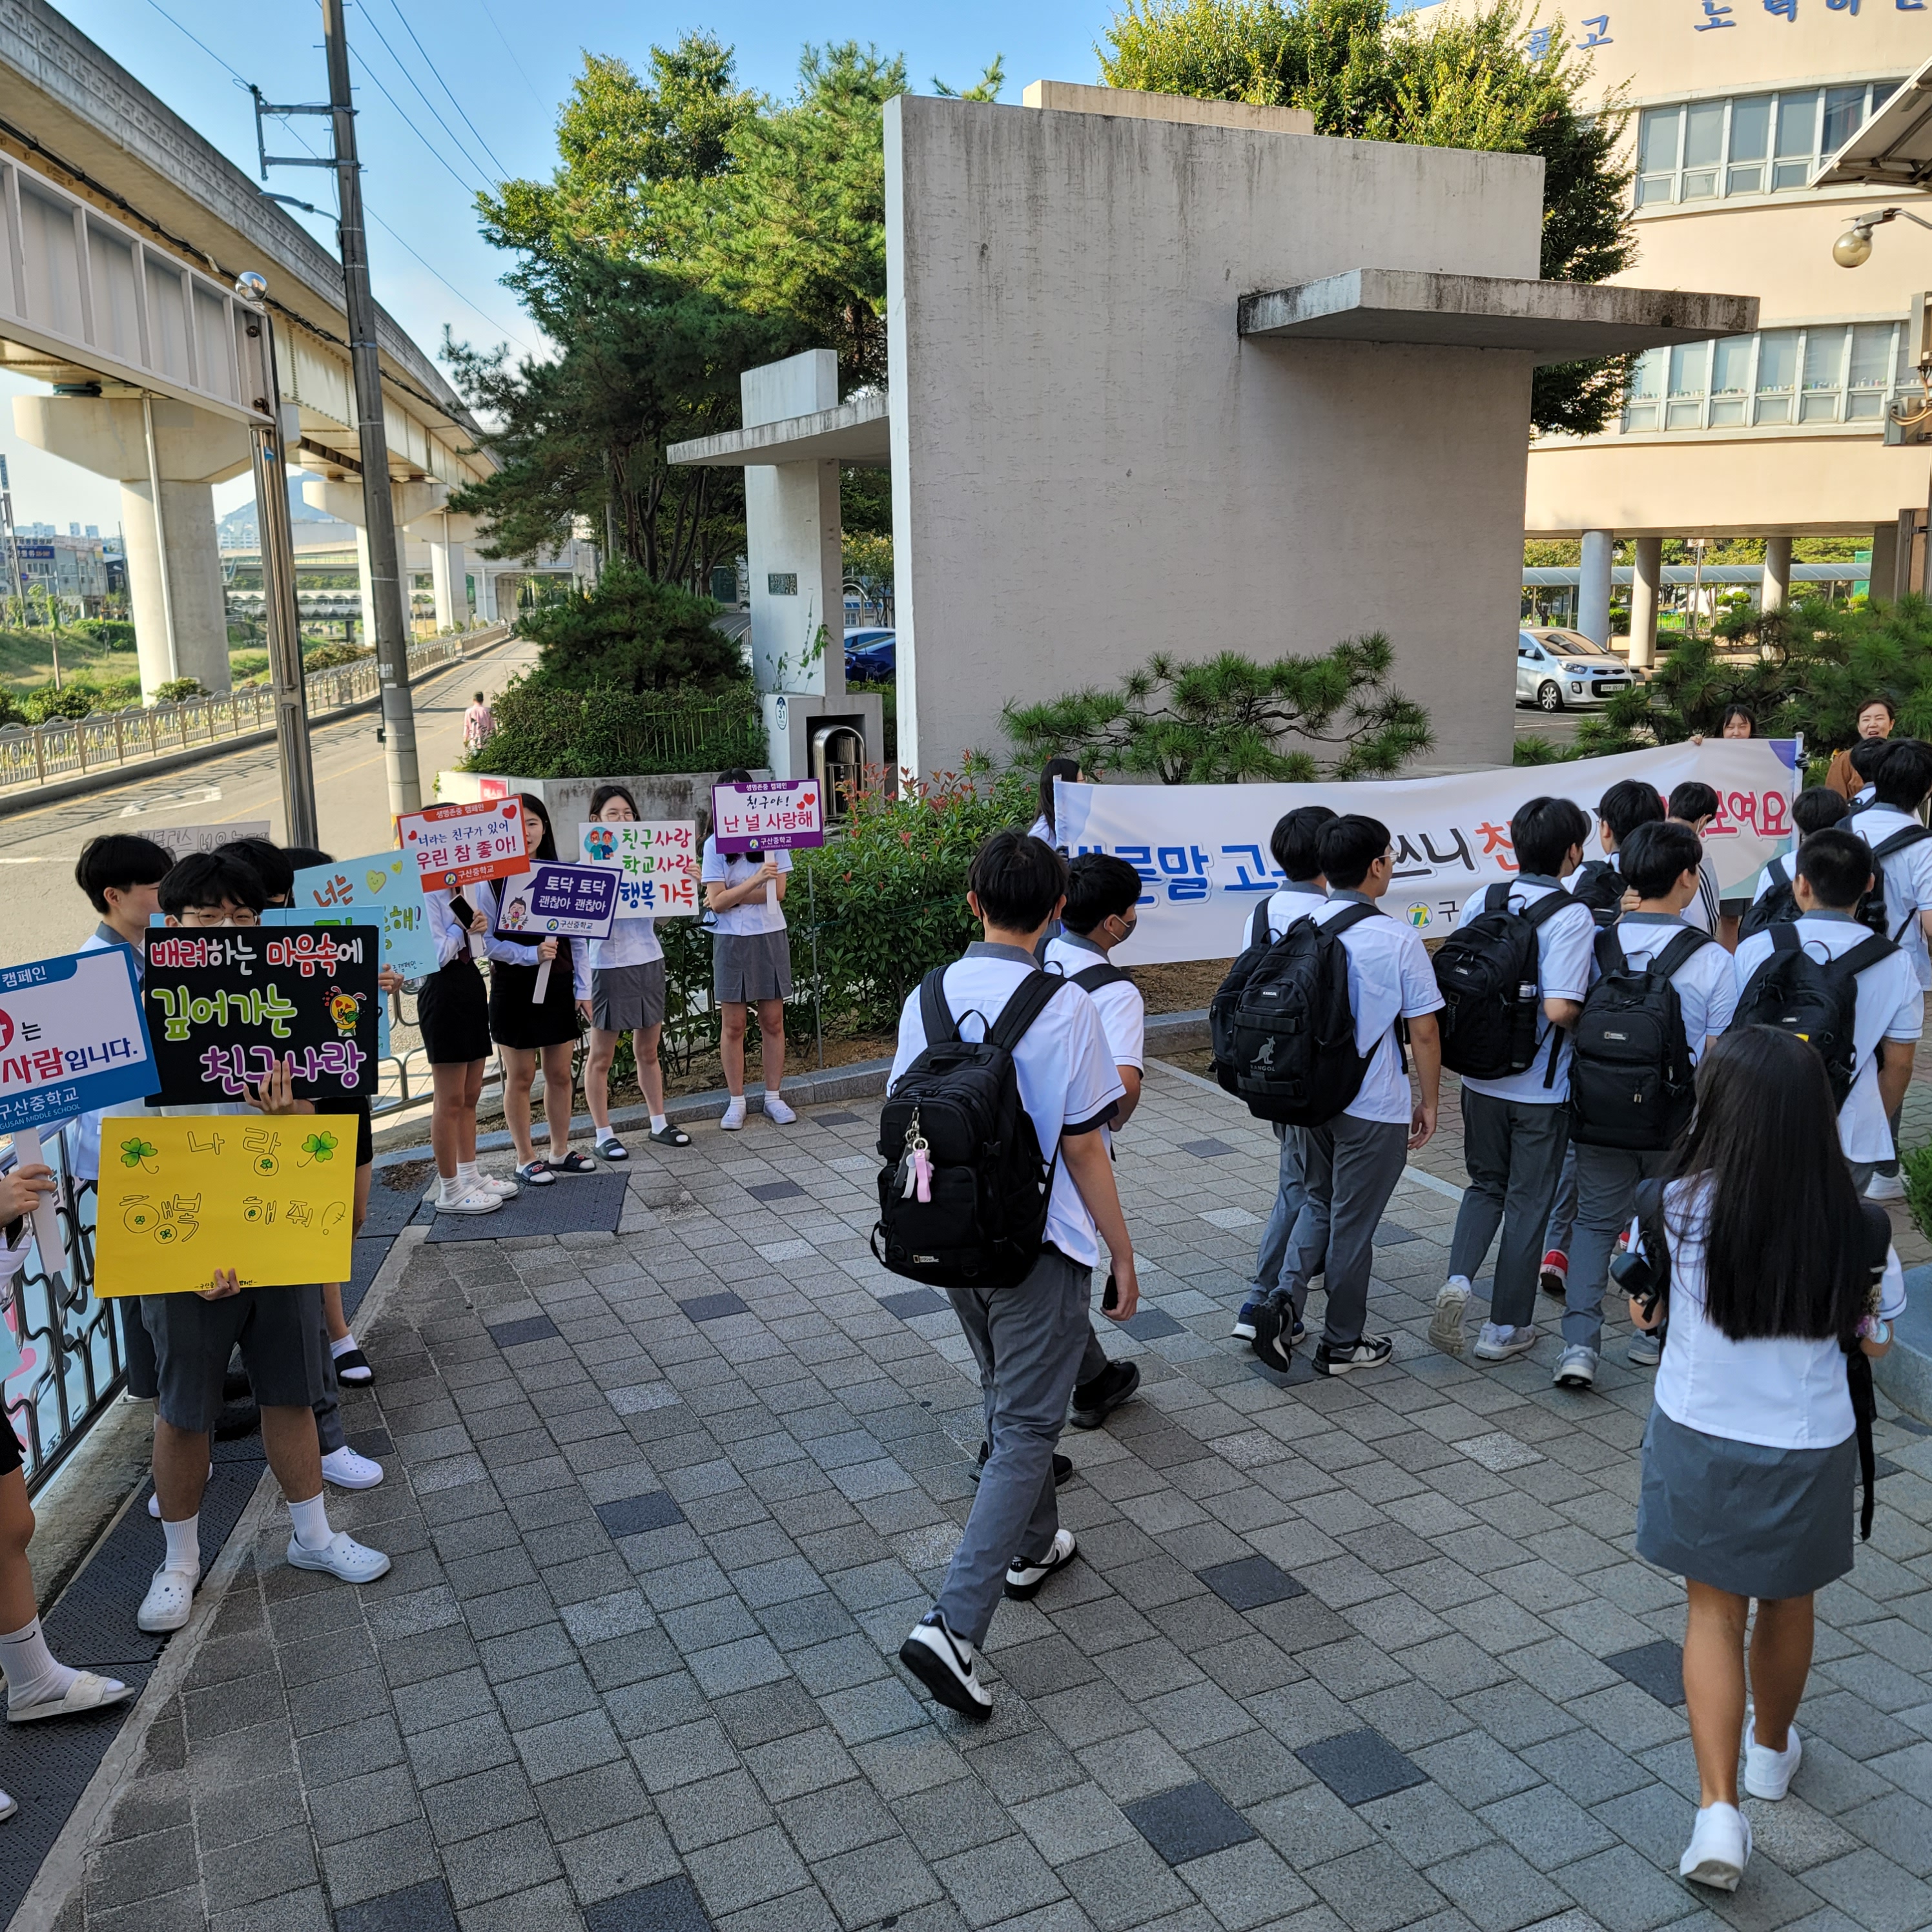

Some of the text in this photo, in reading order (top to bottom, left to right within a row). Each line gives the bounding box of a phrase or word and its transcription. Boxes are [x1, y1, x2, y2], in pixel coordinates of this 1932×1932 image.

[778, 710, 785, 719] 31
[746, 783, 768, 792] 생명존중
[436, 803, 484, 819] 생명존중 캠페인
[746, 795, 790, 810] 친구야!
[418, 819, 509, 847] 너라는 친구가 있어
[724, 810, 813, 834] 난 널 사랑해
[622, 828, 692, 850] 친구사랑
[760, 836, 792, 846] 구산중학교
[416, 848, 449, 870] 우린
[454, 844, 471, 863] 참
[622, 854, 694, 876] 학교사랑
[458, 865, 495, 879] 구산중학교
[313, 874, 354, 907] 너는
[545, 876, 606, 896] 토닥 토닥
[620, 879, 695, 910] 행복 가득
[539, 895, 606, 913] 괜찮아 괜찮아
[560, 920, 594, 930] 구산중학교
[150, 932, 363, 977] 배려하는 마음속에
[2, 965, 47, 987] 캠페인
[151, 983, 298, 1041] 깊어가는
[3, 1037, 138, 1084] 사람입니다.
[0, 1087, 79, 1120] 구산중학교
[0, 1103, 81, 1130] GUSAN MIDDLE SCHOOL
